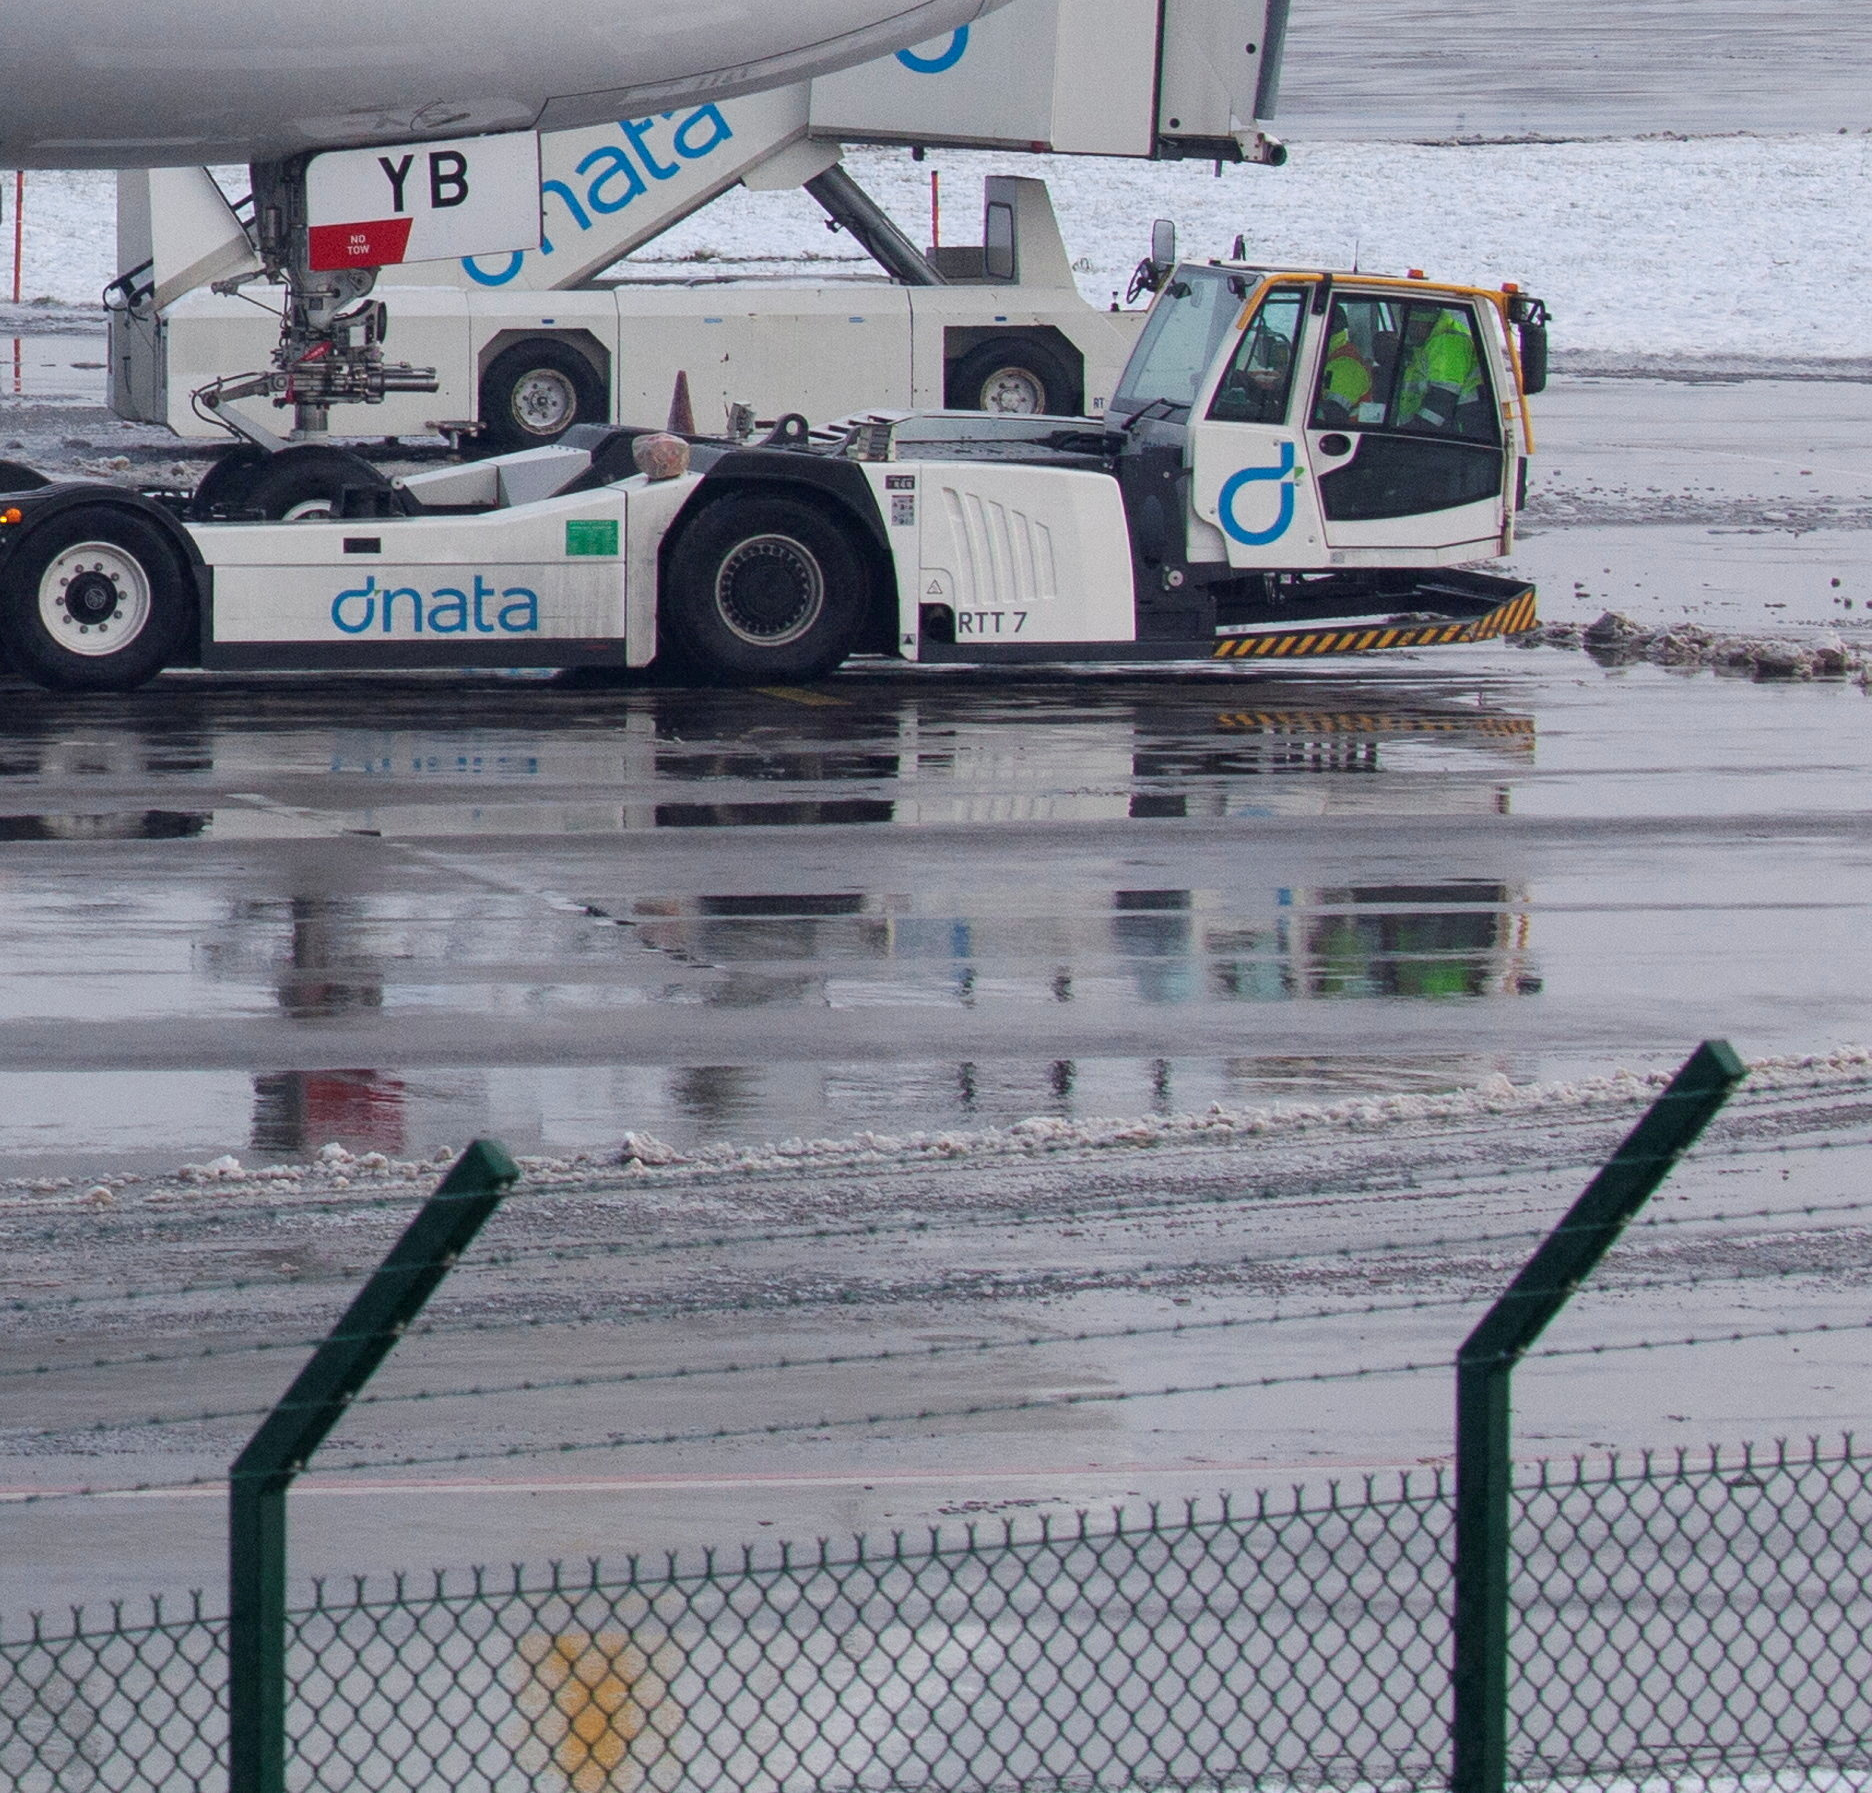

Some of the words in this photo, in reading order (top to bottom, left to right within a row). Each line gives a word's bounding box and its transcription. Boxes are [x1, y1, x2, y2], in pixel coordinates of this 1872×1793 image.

[377, 150, 470, 213] YB
[347, 244, 370, 255] TOW
[350, 234, 366, 245] NO
[331, 574, 539, 634] dnata
[958, 611, 1006, 634] RTT
[1013, 611, 1028, 634] 7
